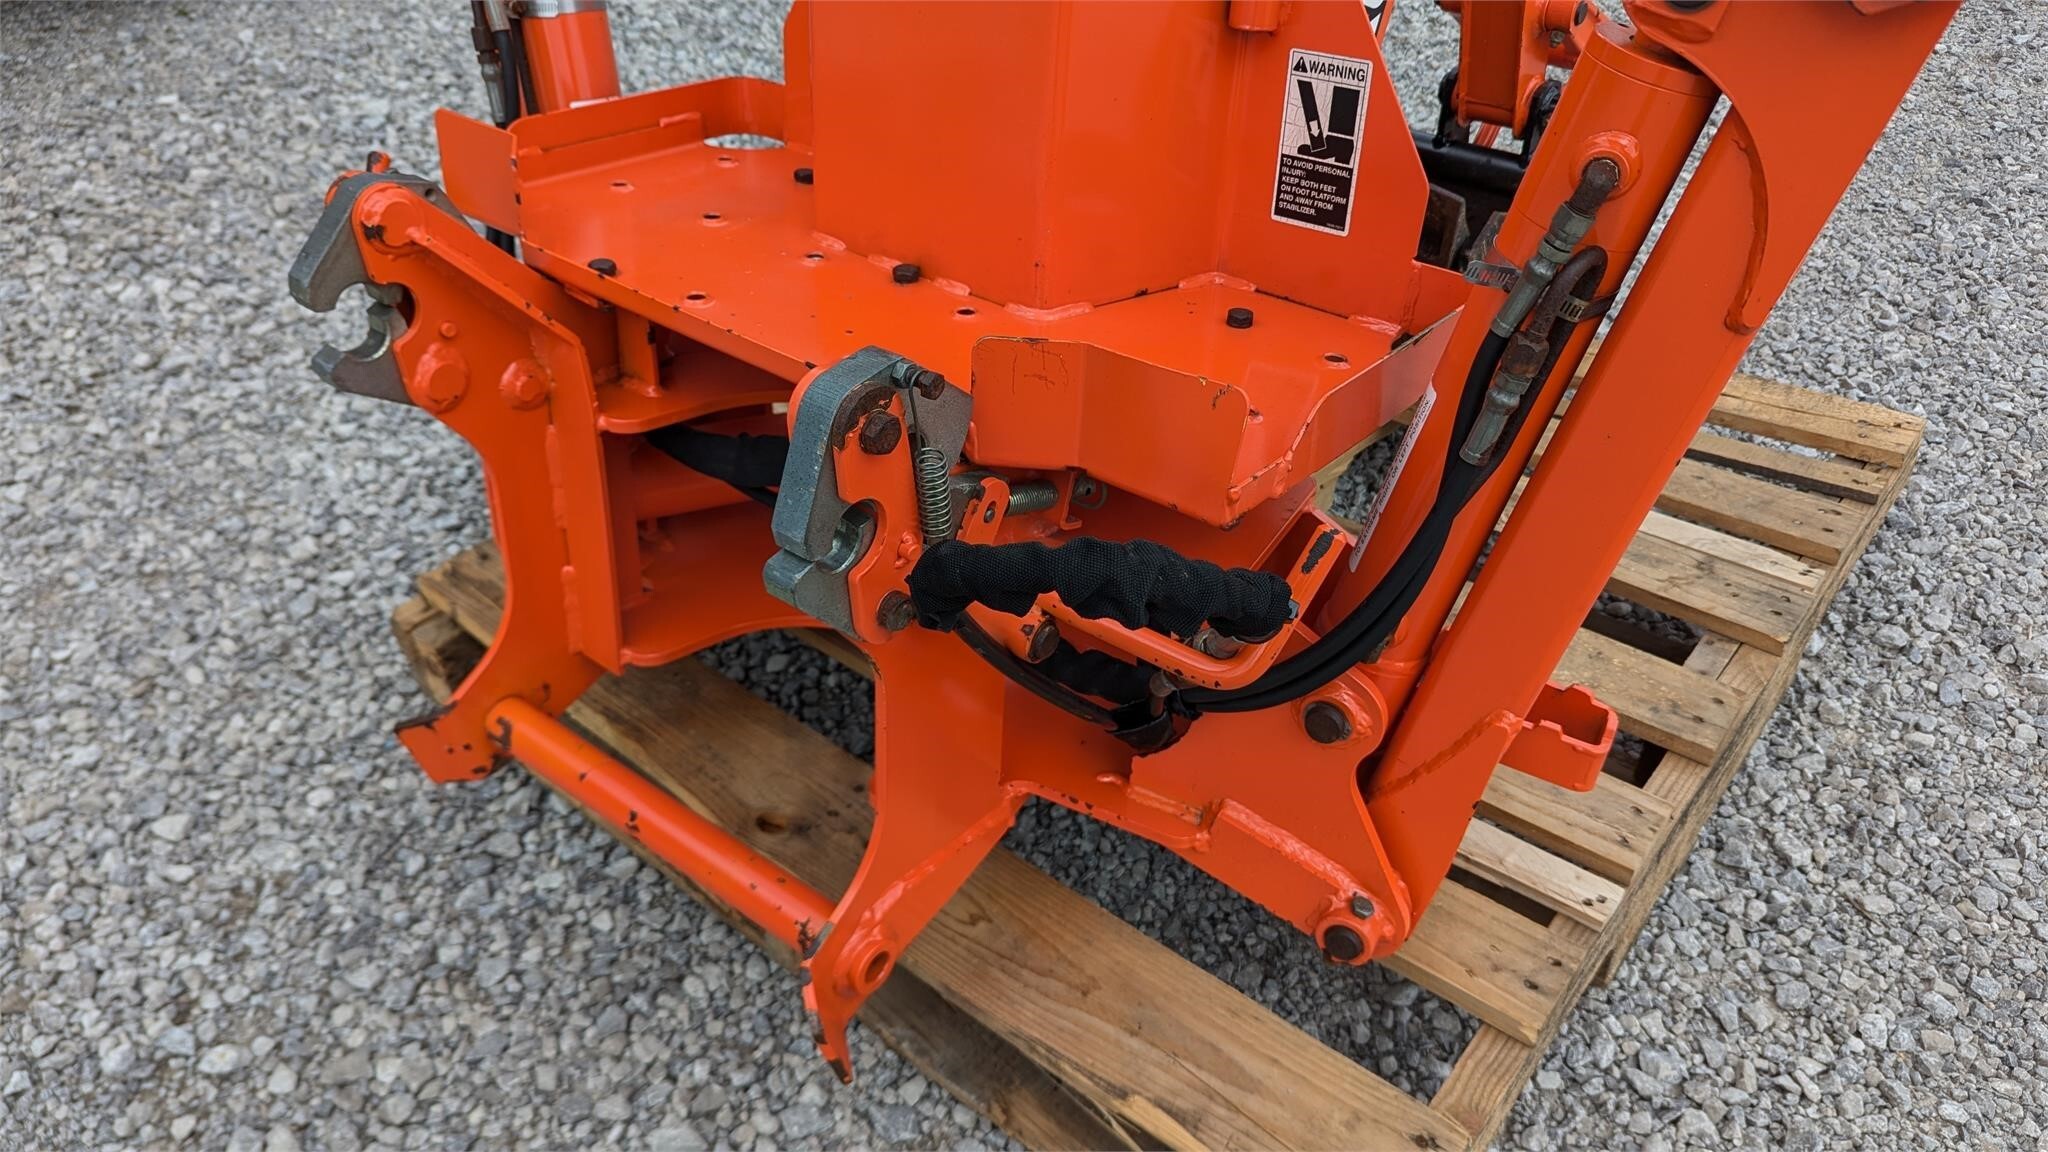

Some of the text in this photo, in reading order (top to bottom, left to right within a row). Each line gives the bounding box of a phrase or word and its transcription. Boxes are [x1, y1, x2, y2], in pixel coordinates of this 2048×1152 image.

[1309, 60, 1365, 82] WARNING
[1293, 160, 1313, 170] AVOID
[1315, 165, 1350, 178] PERSONAL
[1282, 176, 1336, 193] KEEP BOTH FEET
[1279, 193, 1333, 211] AND AWAY FROM
[1292, 187, 1310, 196] FOOT
[1311, 191, 1346, 205] PLATFORM
[1279, 201, 1317, 216] STABILIZER.
[1379, 481, 1391, 506] RIGHT
[1399, 442, 1409, 464] LEFT
